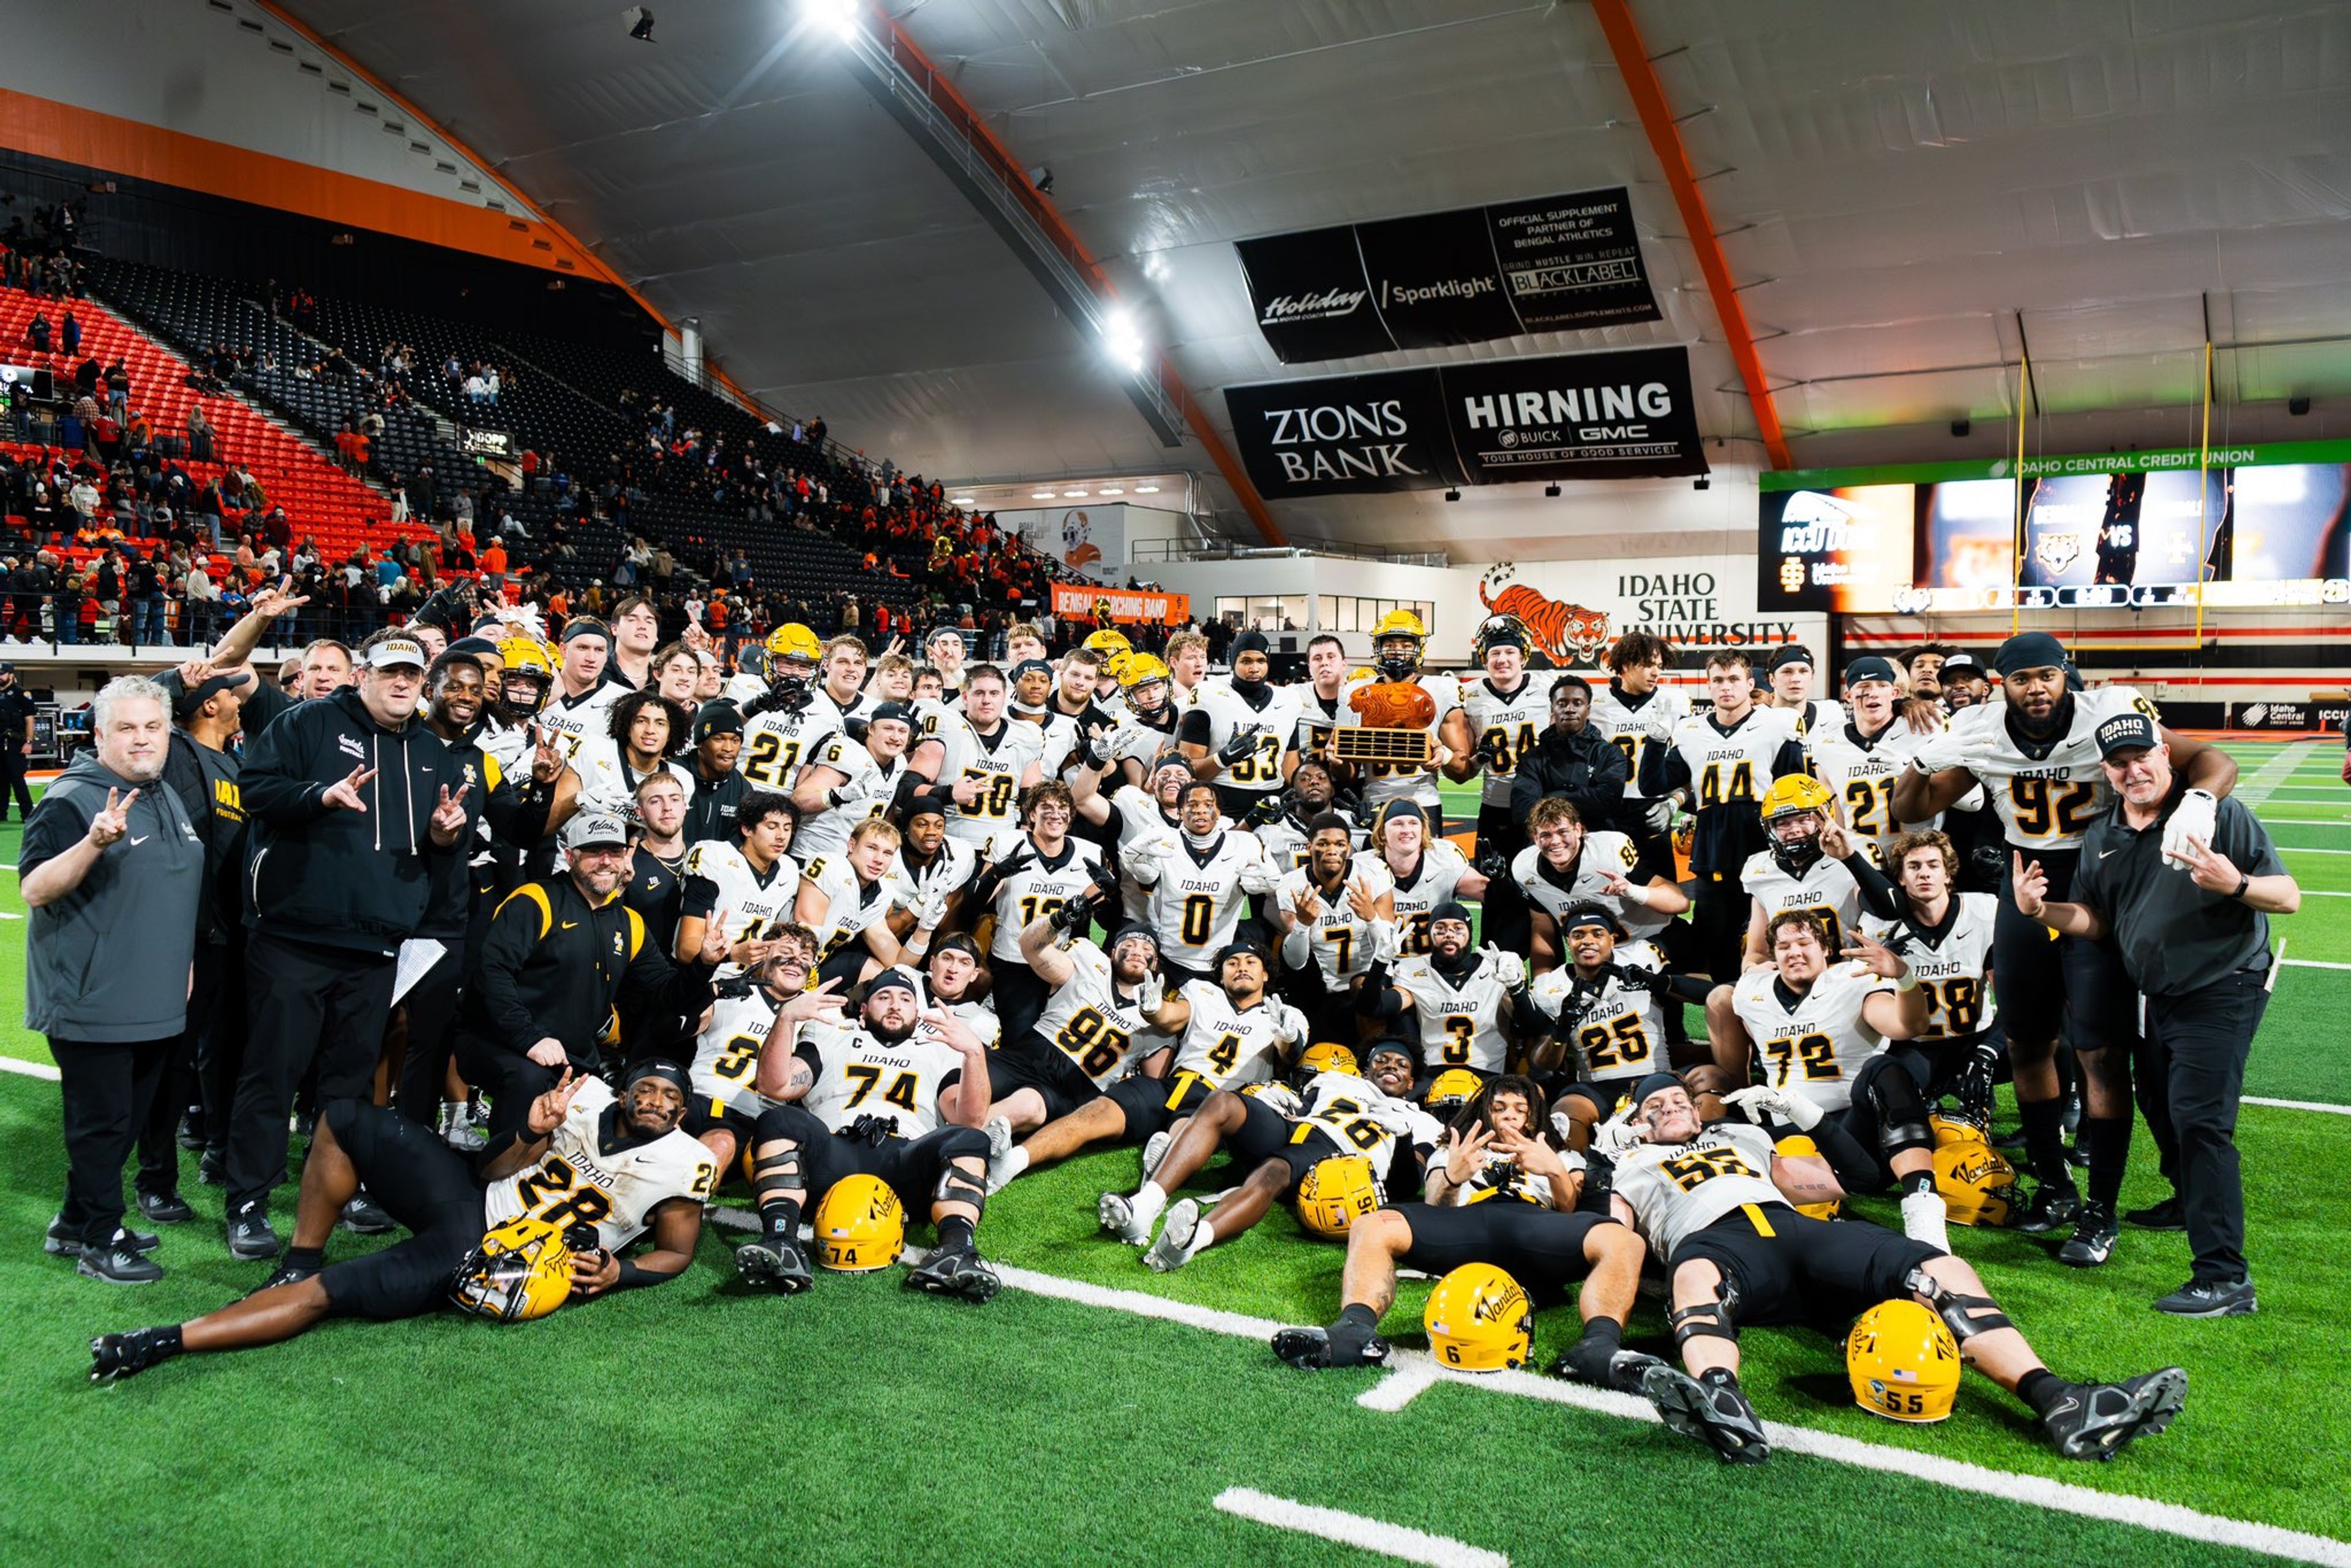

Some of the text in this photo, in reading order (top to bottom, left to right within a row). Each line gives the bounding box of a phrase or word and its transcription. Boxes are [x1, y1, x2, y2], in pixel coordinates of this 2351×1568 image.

[1499, 203, 1618, 227] OFFICIAL SUPPLEMENT
[1526, 218, 1594, 235] PARTNER OF
[1513, 227, 1614, 249] BENGAL ATHLETICS
[1502, 246, 1637, 272] GRIND HUSTLE WIN REPEAT
[1392, 277, 1496, 305] Sparklight
[1264, 287, 1367, 318] Holiday
[1524, 304, 1652, 324] BLACKLABELSUPPLEMENTS.COM
[1464, 382, 1672, 429] HIRNING
[1264, 400, 1408, 445] ZIONS
[1520, 425, 1649, 443] BUICK GMC
[1274, 443, 1423, 483] BANK
[1482, 445, 1676, 463] YOUR HOUSE OF GOOD SERVICE!
[2013, 450, 2255, 474] IDAHO CENTRAL CREDIT UNION
[2110, 524, 2133, 548] VS
[1618, 572, 1716, 597] IDAHO
[1058, 591, 1093, 613] BENGAL
[1144, 597, 1168, 618] BAND
[1638, 598, 1719, 621] STATE
[1622, 622, 1794, 647] UNIVERSITY
[386, 643, 418, 654] IDAHO
[1491, 711, 1526, 725] IDAHO
[2270, 704, 2296, 713] Idaho
[2270, 711, 2305, 721] Central
[546, 715, 584, 733] DAHO
[762, 719, 800, 738] IDAHO
[2101, 719, 2145, 738] IDAHO
[2105, 729, 2143, 743] FOOTBALL
[743, 732, 801, 789] 21
[975, 758, 1009, 773] IDAHO
[1707, 749, 1744, 761] IDAHO
[872, 789, 893, 800] IDAHO
[1698, 759, 1755, 811] 44
[2008, 774, 2094, 838] 92
[588, 819, 619, 835] Idaho
[686, 846, 703, 871] 4
[805, 857, 828, 880] 5
[1029, 882, 1064, 895] IDAHO
[1180, 879, 1220, 893] IDAHO
[741, 901, 773, 917] IDAHO
[1393, 901, 1428, 912] IDAHO
[1782, 891, 1823, 907] IDAHO
[836, 915, 861, 931] IDAHO
[1181, 893, 1215, 947] 0
[1319, 912, 1352, 926] IDAHO
[1322, 925, 1354, 975] 7
[1914, 961, 1960, 977] IDAHO
[1095, 1002, 1131, 1030] IDAHO
[1439, 1002, 1479, 1013] IDAHO
[1585, 1002, 1624, 1024] IDAHO
[748, 1021, 771, 1036] IDA
[1213, 1020, 1253, 1035] IDAHO
[1774, 1023, 1817, 1038] IDAHO
[852, 1037, 863, 1049] C
[1054, 1004, 1131, 1079] 96
[1441, 1015, 1475, 1065] 3
[1579, 1010, 1649, 1071] 25
[714, 1033, 761, 1093] 3
[861, 1053, 912, 1068] IDAHO
[1207, 1031, 1243, 1076] 4
[1766, 1032, 1842, 1089] 72
[844, 1064, 919, 1114] 74
[567, 1152, 614, 1188] IDAHO
[519, 1155, 613, 1232] 28
[830, 1247, 858, 1265] 74
[1445, 1345, 1461, 1364] 6
[1886, 1390, 1924, 1414] 55
